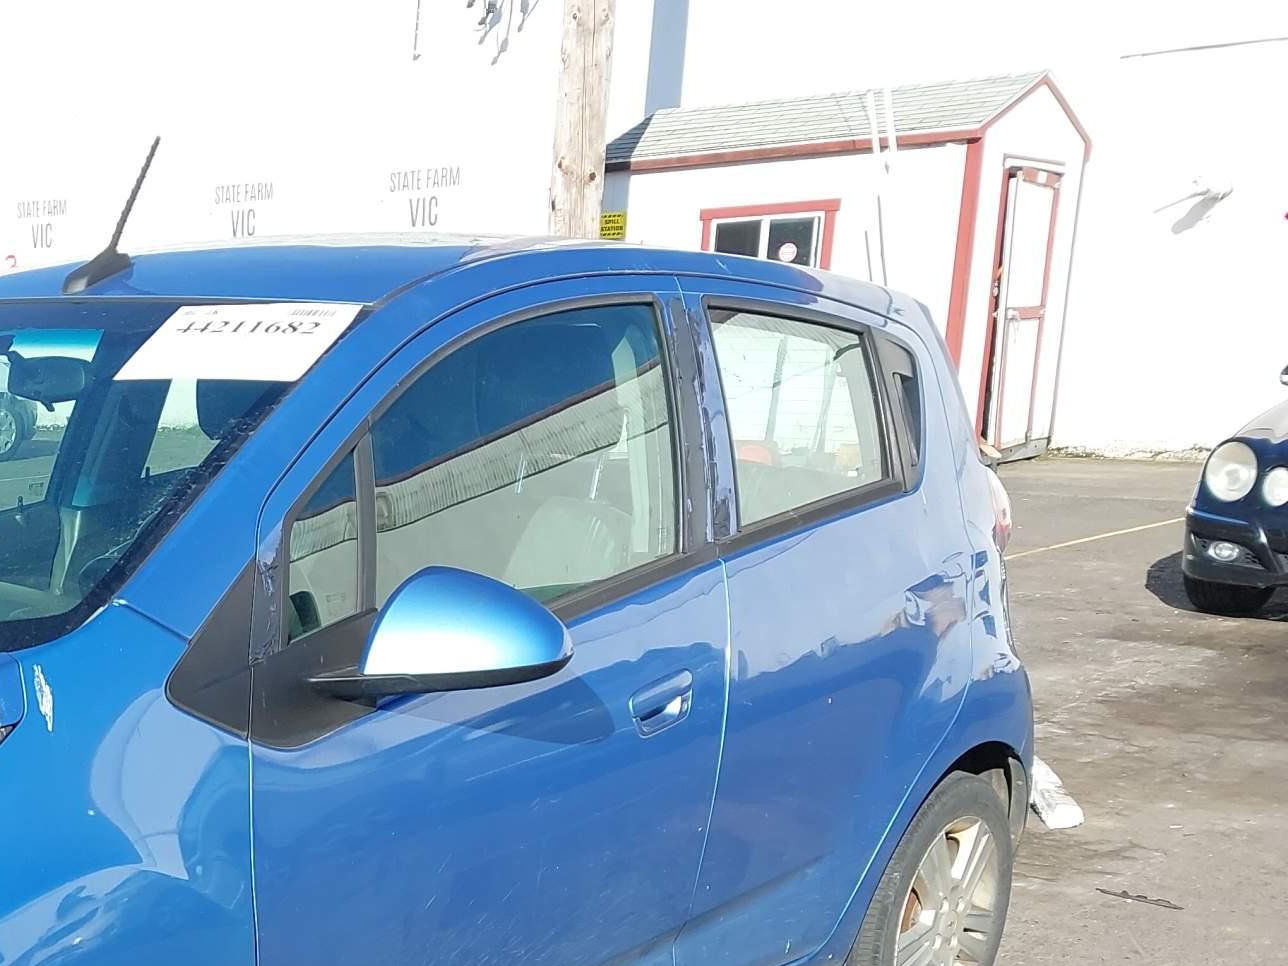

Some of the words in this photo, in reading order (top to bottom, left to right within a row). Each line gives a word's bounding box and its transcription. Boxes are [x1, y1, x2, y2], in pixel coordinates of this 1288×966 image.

[388, 169, 422, 193] STATE
[426, 166, 460, 189] FARM
[215, 184, 241, 205] STATE
[244, 182, 273, 202] FARM
[17, 200, 40, 219] STATE
[42, 198, 67, 216] FARM
[408, 196, 438, 228] VIC
[31, 223, 53, 249] VIC
[231, 208, 256, 238] VIC
[176, 320, 321, 335] 44211682
